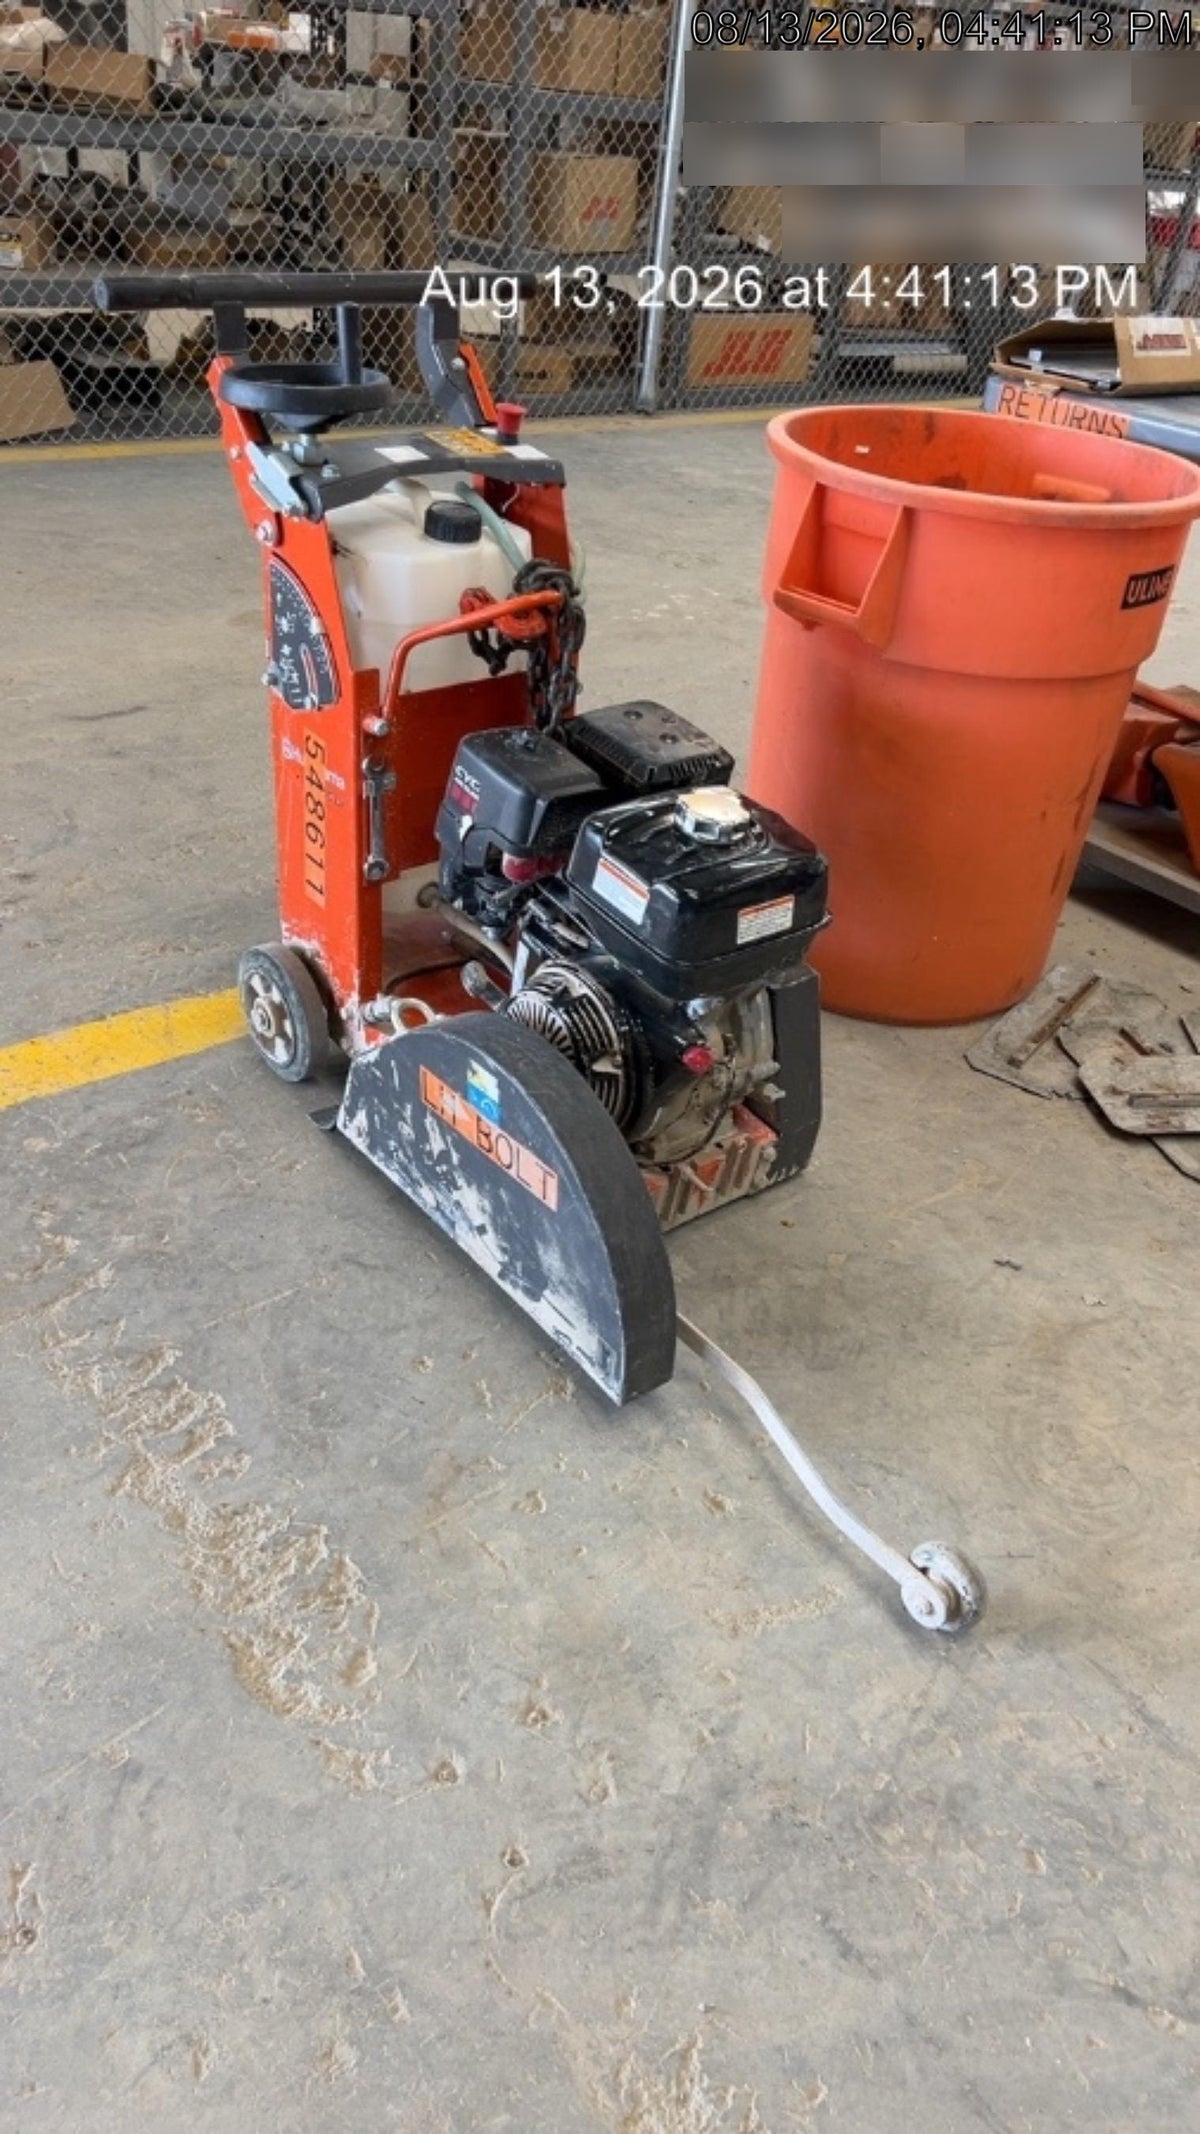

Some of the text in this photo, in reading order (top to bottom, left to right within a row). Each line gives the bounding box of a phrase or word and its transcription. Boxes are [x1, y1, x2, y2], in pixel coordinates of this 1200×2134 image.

[998, 381, 1127, 439] RETURNS
[304, 734, 326, 896] 548611
[476, 1114, 557, 1201] BOLT
